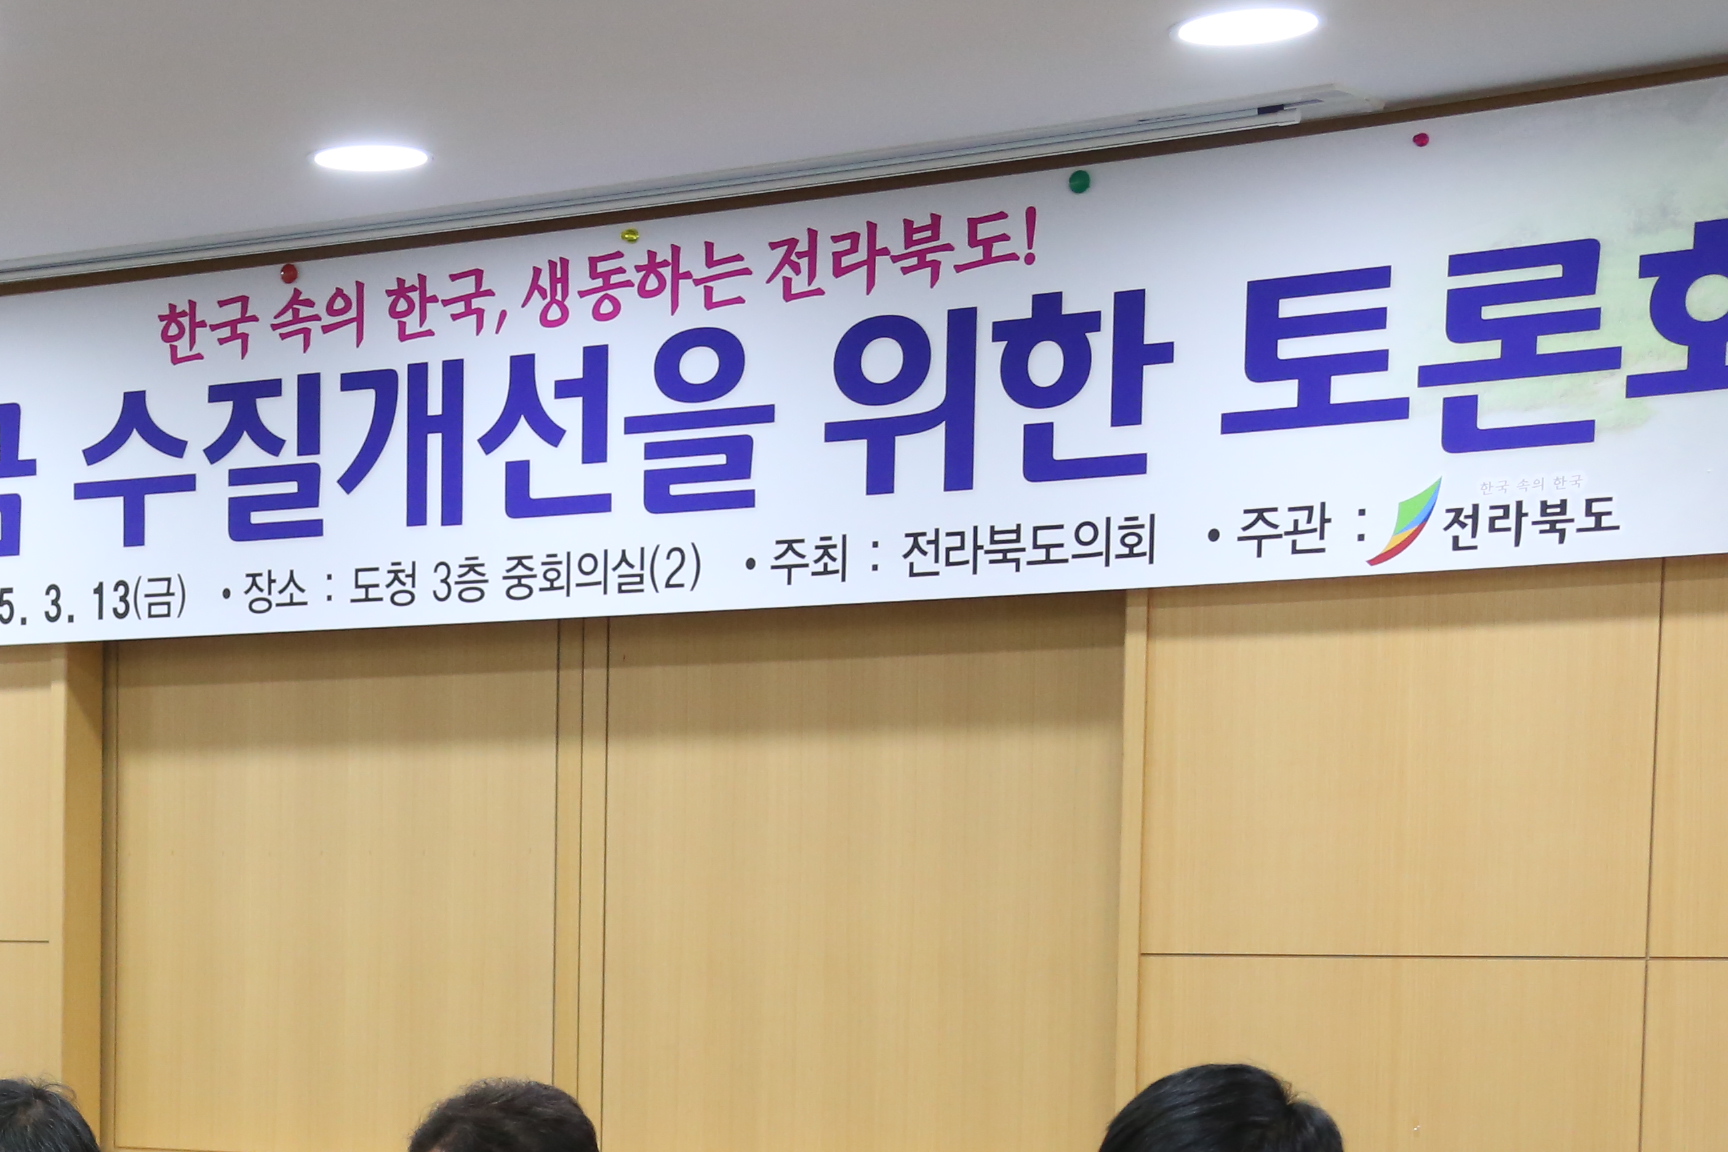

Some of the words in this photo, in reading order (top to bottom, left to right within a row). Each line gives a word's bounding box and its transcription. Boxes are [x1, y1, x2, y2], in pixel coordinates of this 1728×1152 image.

[158, 295, 260, 365] 한국
[270, 281, 365, 353] 속의
[385, 267, 509, 342] 한국,
[522, 241, 754, 329] 생동하는
[766, 206, 1037, 302] 전라북도!
[73, 326, 776, 549] 수질개선을
[824, 290, 1175, 496] 위한
[1480, 480, 1510, 496] 한국
[1517, 476, 1545, 492] 속의
[1553, 474, 1584, 491] 한국
[770, 533, 848, 586] 주최
[902, 513, 1156, 578] 전라북도의회
[1237, 501, 1333, 559] 주관
[1443, 497, 1620, 551] 전라북도
[44, 583, 75, 624] 3.
[93, 573, 186, 621] 13(금)
[243, 569, 309, 615] 장소
[350, 560, 417, 606] 도청
[432, 555, 490, 604] 3층
[502, 541, 702, 601] 중회의실(2)
